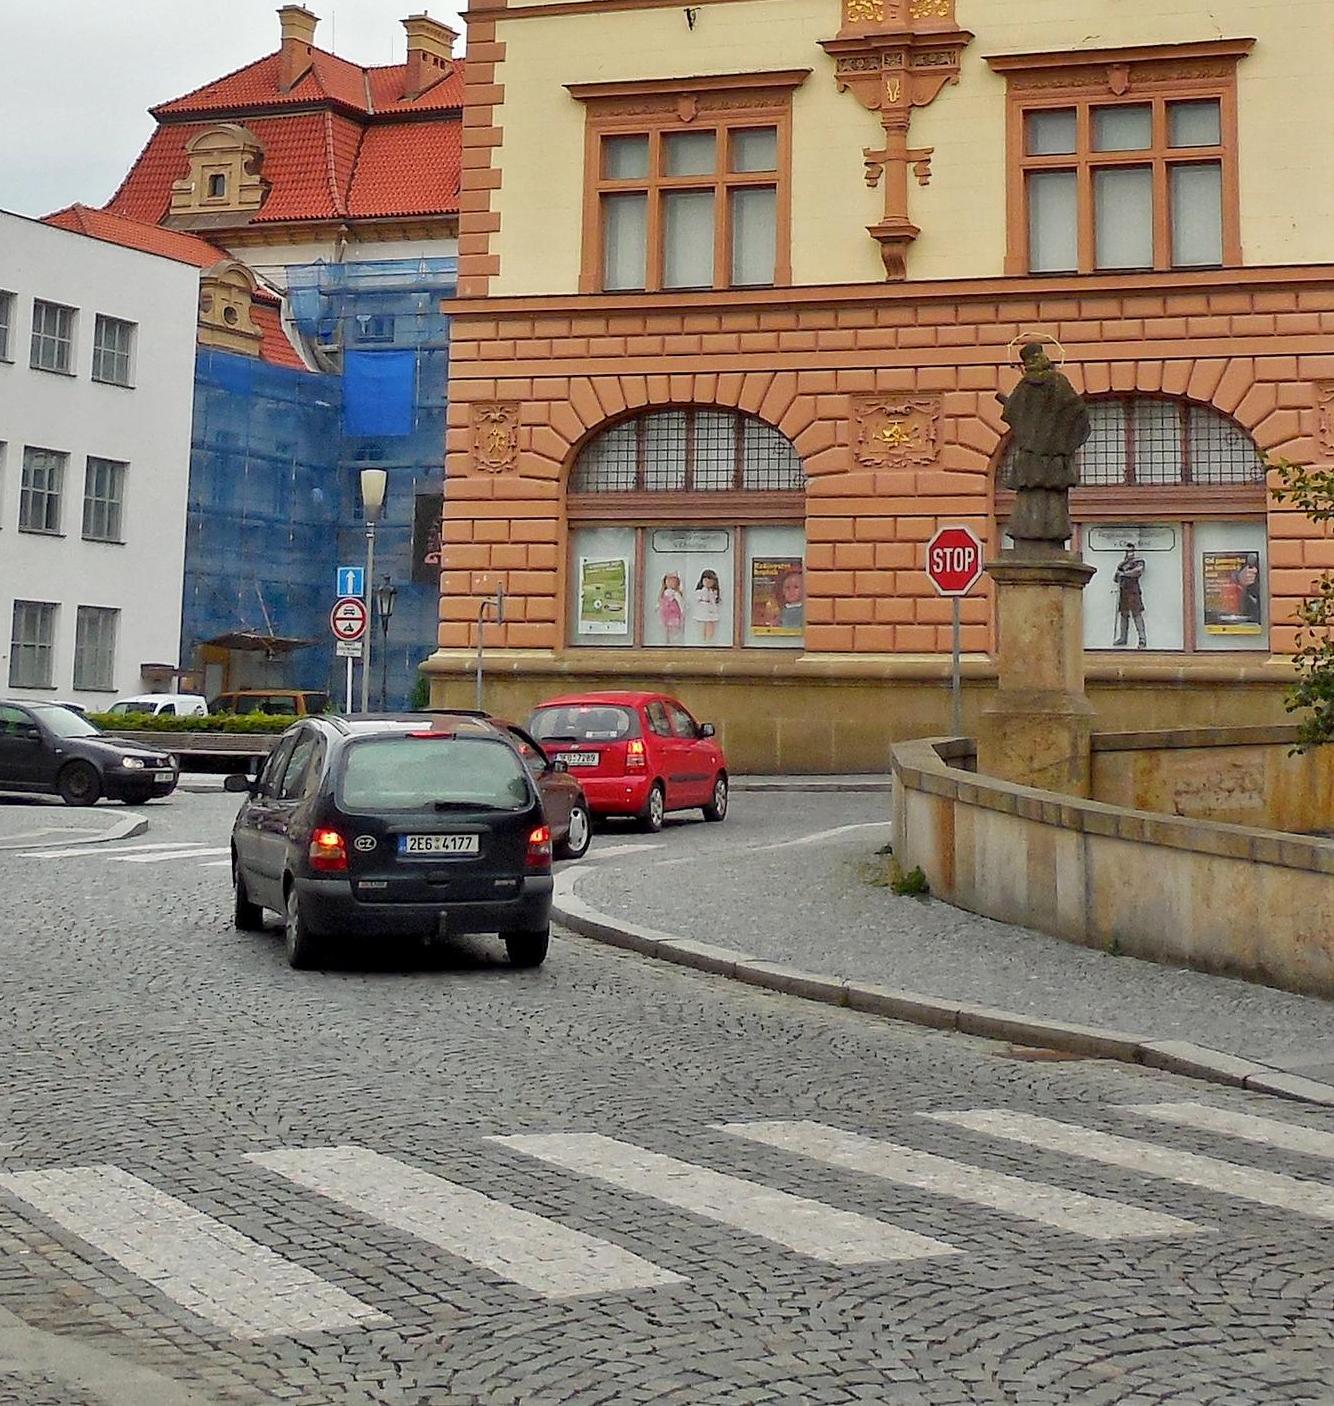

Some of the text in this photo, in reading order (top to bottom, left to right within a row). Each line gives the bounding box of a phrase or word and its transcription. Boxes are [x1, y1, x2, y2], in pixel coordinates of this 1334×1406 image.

[932, 546, 975, 573] STOP
[409, 837, 473, 851] 2E6 4177
